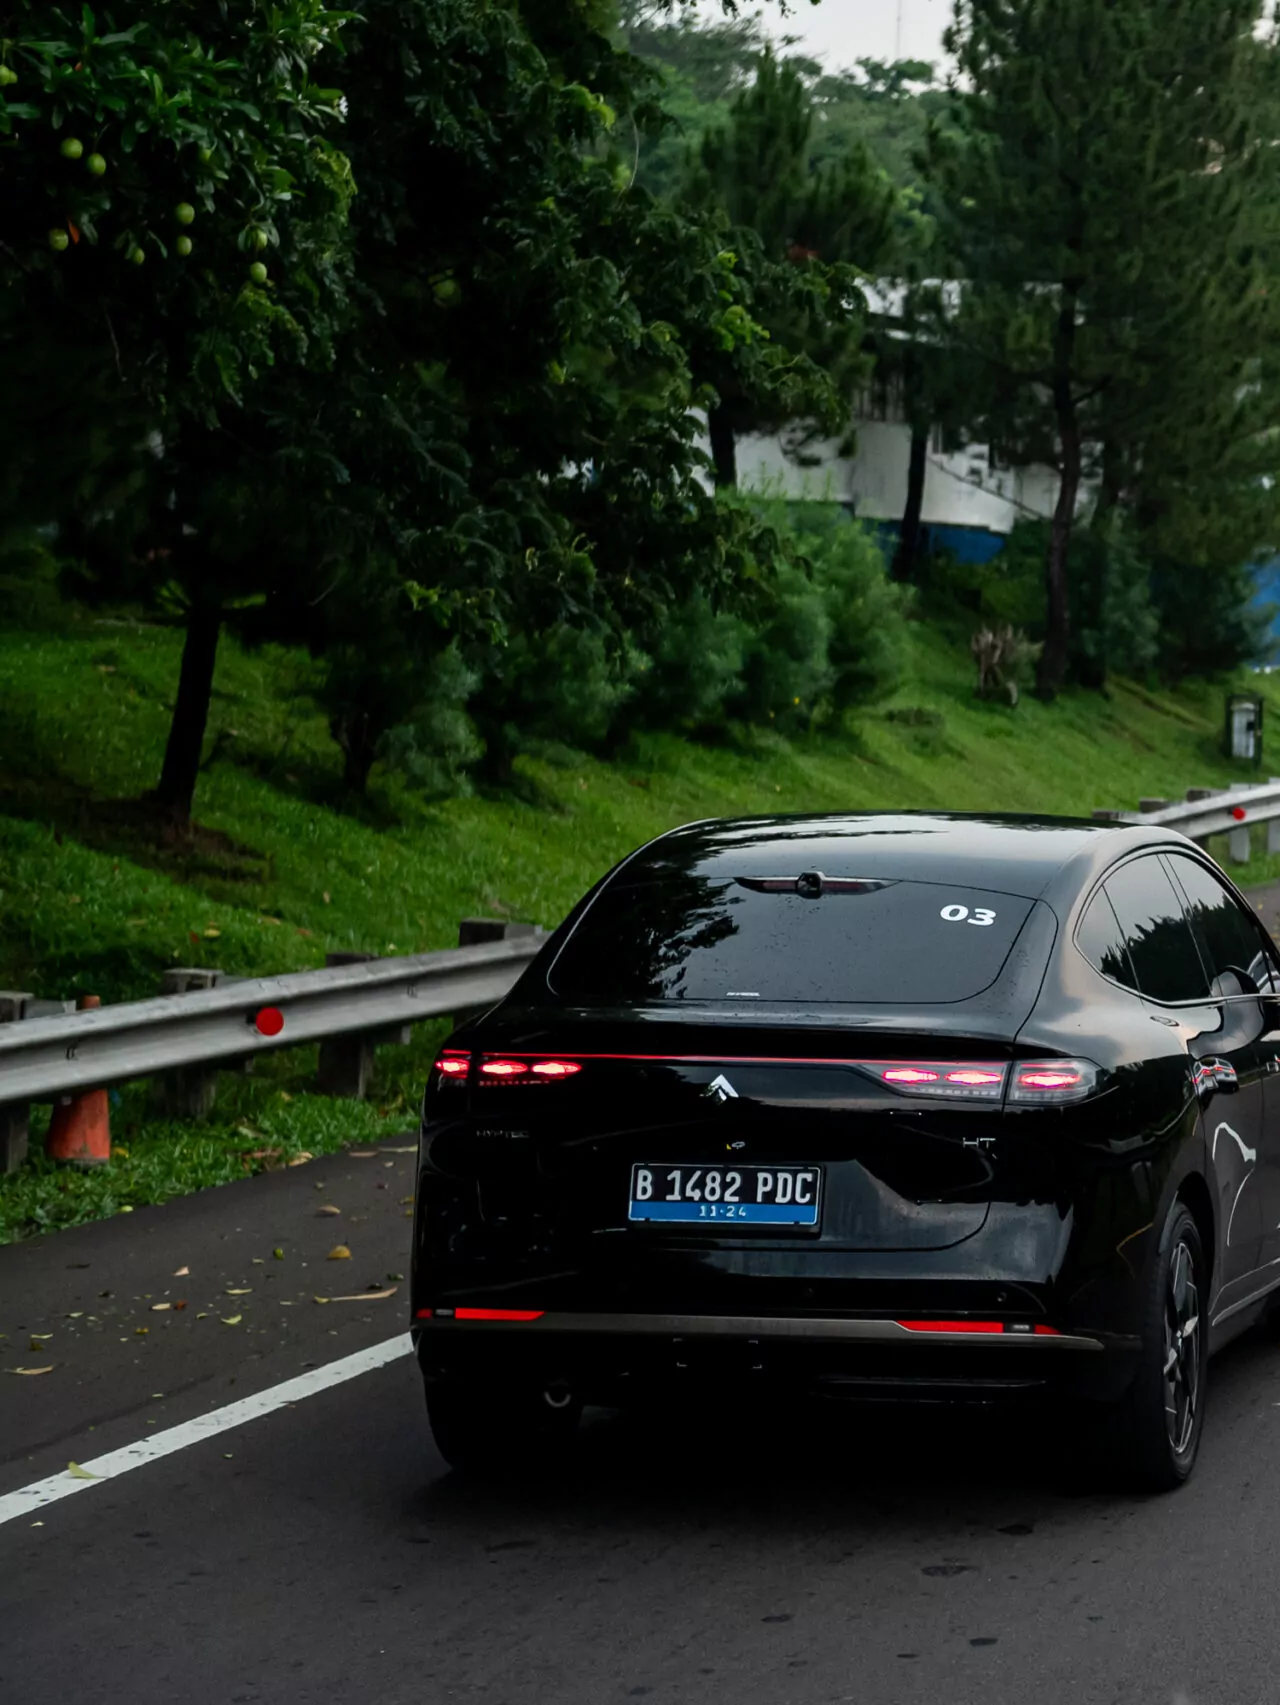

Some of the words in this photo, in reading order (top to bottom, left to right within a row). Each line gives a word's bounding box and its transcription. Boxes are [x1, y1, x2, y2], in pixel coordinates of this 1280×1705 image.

[940, 904, 997, 926] 03
[962, 1136, 996, 1149] HT
[635, 1169, 653, 1201] B
[665, 1169, 742, 1202] 1482
[756, 1171, 813, 1204] PDC
